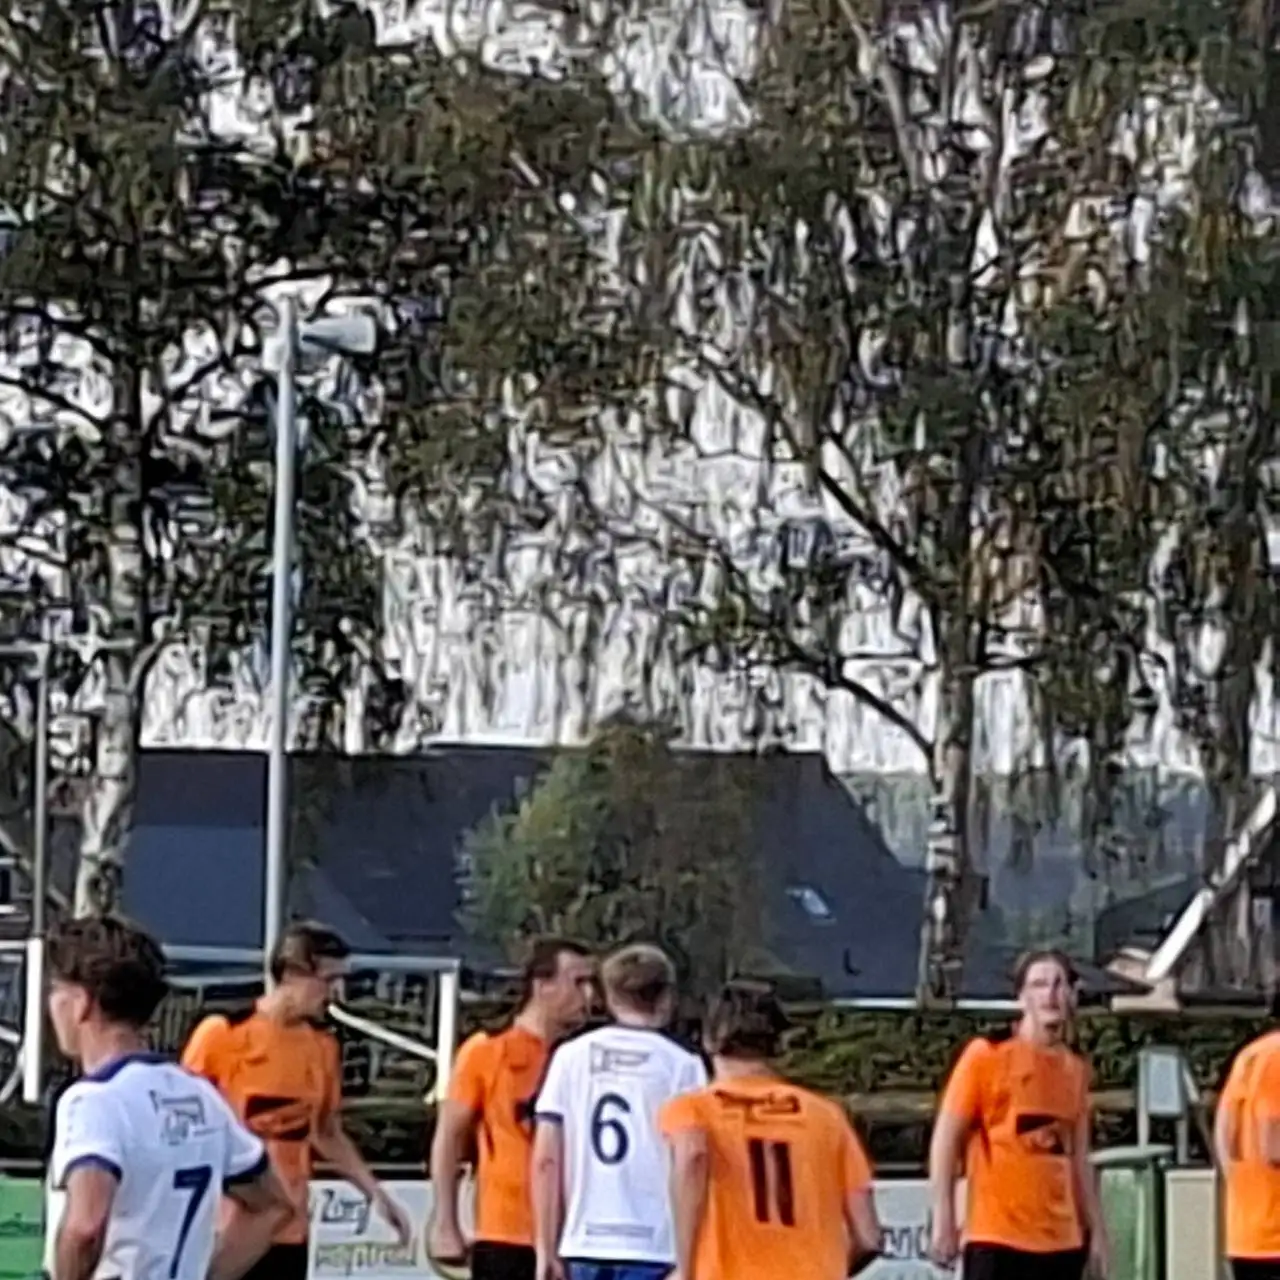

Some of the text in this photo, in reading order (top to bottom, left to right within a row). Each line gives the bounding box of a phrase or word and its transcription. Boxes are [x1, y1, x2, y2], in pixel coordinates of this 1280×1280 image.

[591, 1092, 632, 1166] 6
[173, 1164, 212, 1280] 7
[748, 1137, 796, 1227] 11
